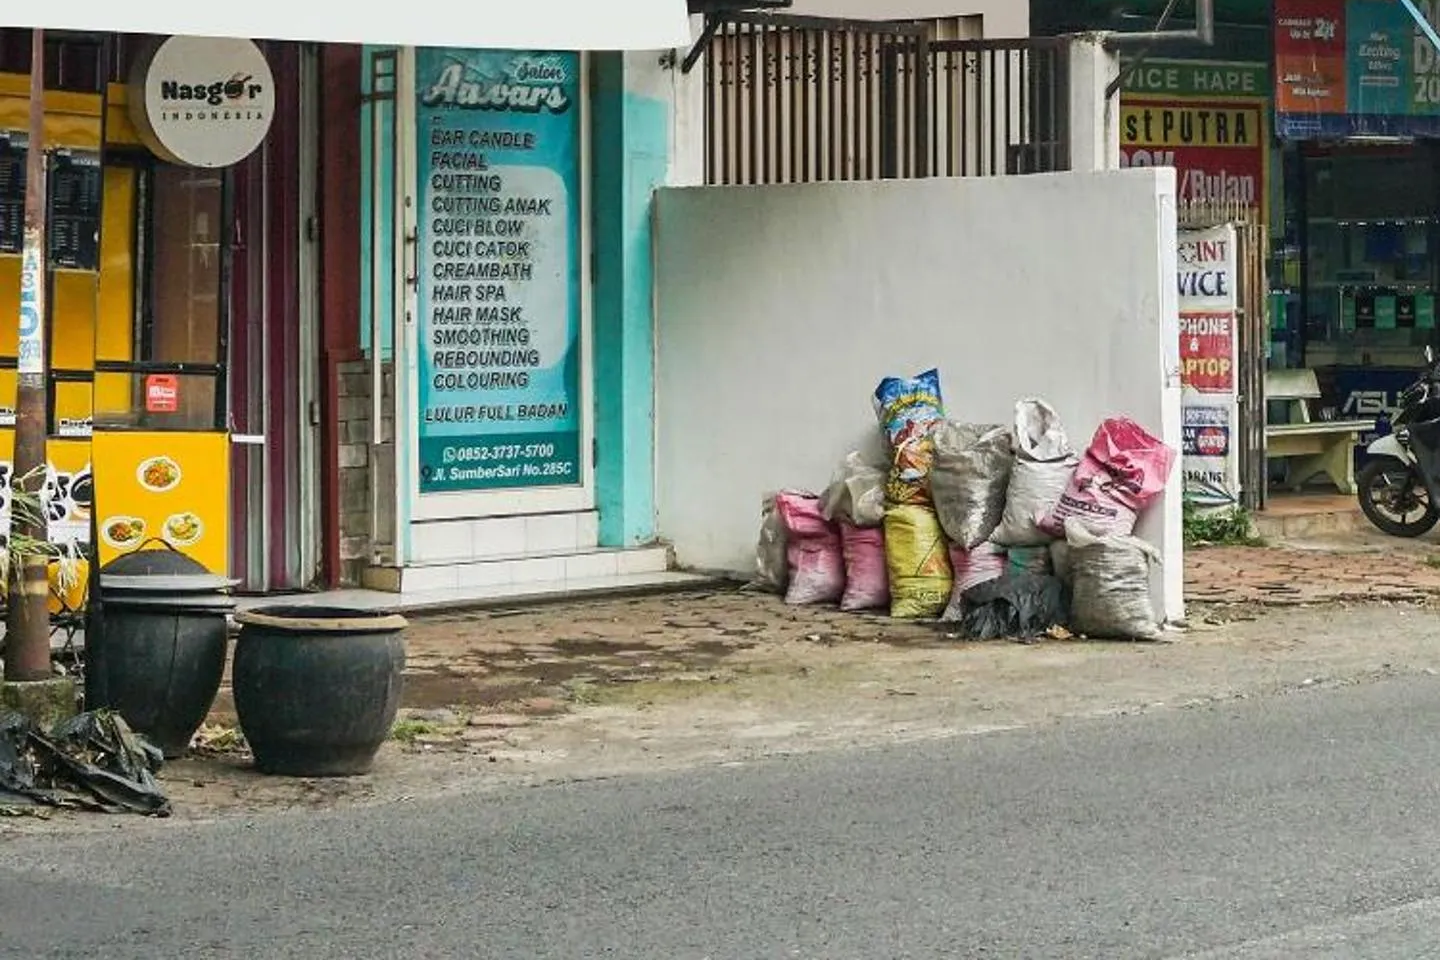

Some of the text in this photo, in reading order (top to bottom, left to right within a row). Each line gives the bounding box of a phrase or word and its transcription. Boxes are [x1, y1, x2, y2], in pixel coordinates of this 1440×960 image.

[1193, 71, 1255, 91] HAPE
[162, 112, 263, 121] INDONESIA
[1163, 111, 1247, 143] PUTRA
[468, 130, 536, 150] CANDLE
[431, 150, 489, 171] FACIAL
[431, 173, 502, 192] CUTTING
[431, 196, 552, 216] CUTTING ANAK
[431, 218, 525, 237] CUCI BLOW
[431, 240, 530, 258] CUCI CATOK
[432, 262, 533, 281] CREAMBATH
[432, 284, 506, 302] HAIR SPA
[432, 306, 522, 325] HAIR MASK
[1178, 318, 1230, 336] PHONE
[433, 327, 531, 347] SMOOTHING
[433, 349, 540, 369] REBOUNDING
[433, 372, 530, 391] COLOURING
[425, 402, 569, 424] LULUR FULL BADAN
[457, 443, 555, 463] 0852-3737-5700
[449, 464, 520, 481] SumberSari
